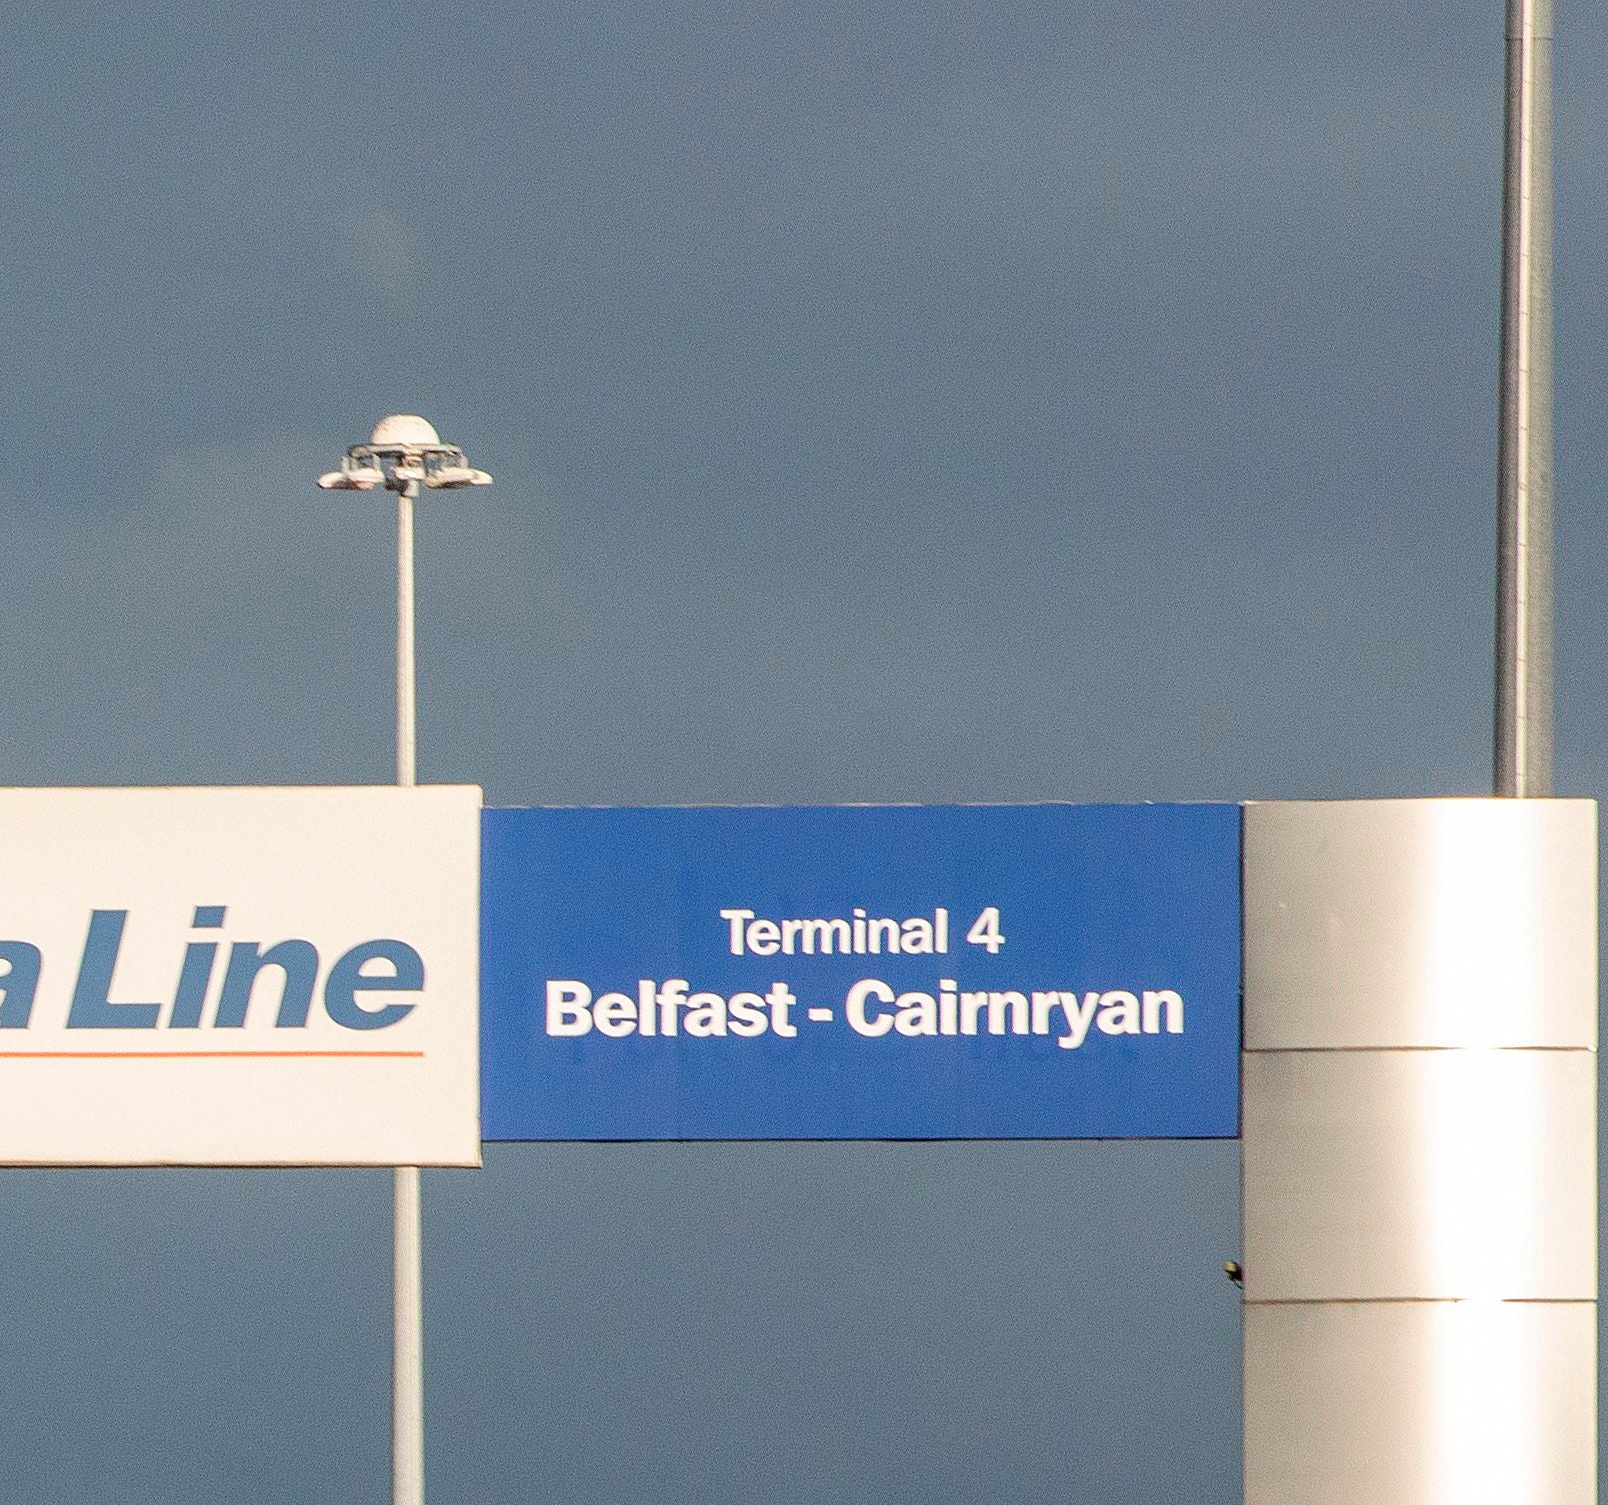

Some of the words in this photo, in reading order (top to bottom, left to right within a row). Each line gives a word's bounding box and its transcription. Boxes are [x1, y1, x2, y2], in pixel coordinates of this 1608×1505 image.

[720, 908, 948, 955] Terminal
[966, 907, 1005, 954] 4
[64, 904, 426, 1031] Line
[545, 979, 797, 1038] Belfast
[845, 978, 1185, 1050] Cairnryan
